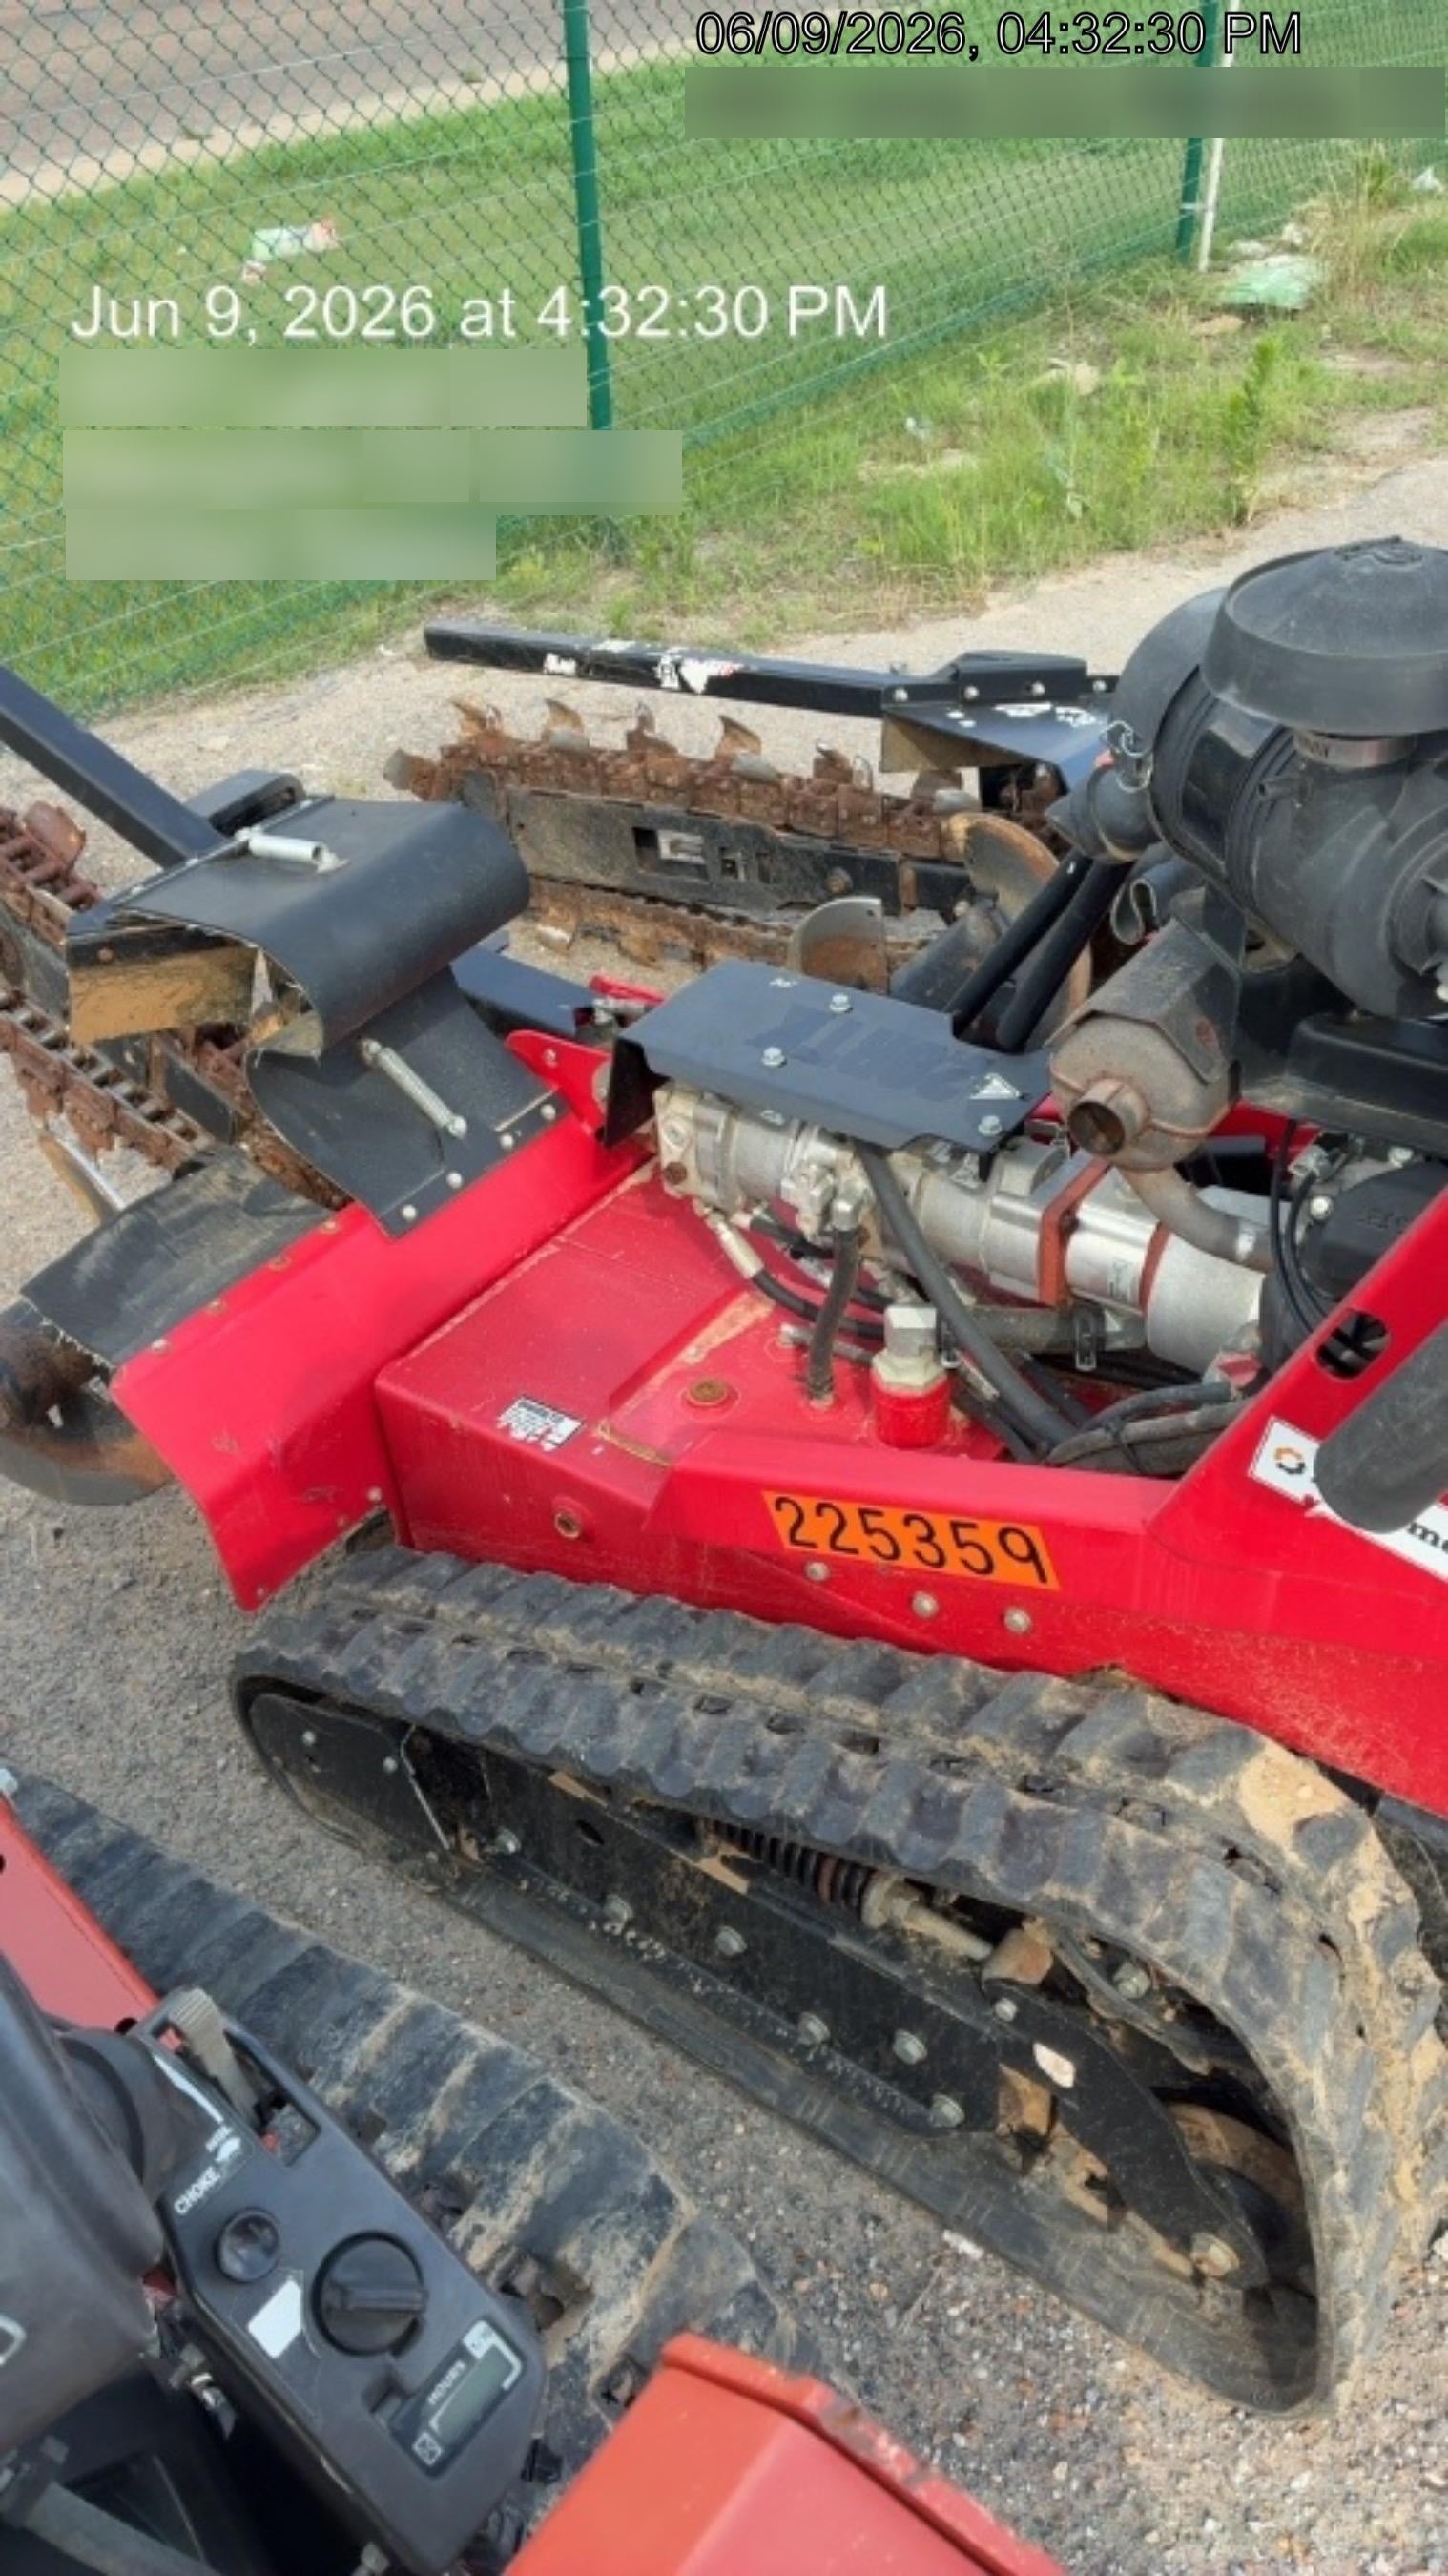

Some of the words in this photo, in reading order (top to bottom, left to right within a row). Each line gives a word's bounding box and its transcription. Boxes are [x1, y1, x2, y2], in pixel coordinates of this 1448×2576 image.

[774, 1495, 1047, 1585] 225359
[174, 2167, 221, 2214] CHOKE
[428, 2360, 465, 2406] HOURS
